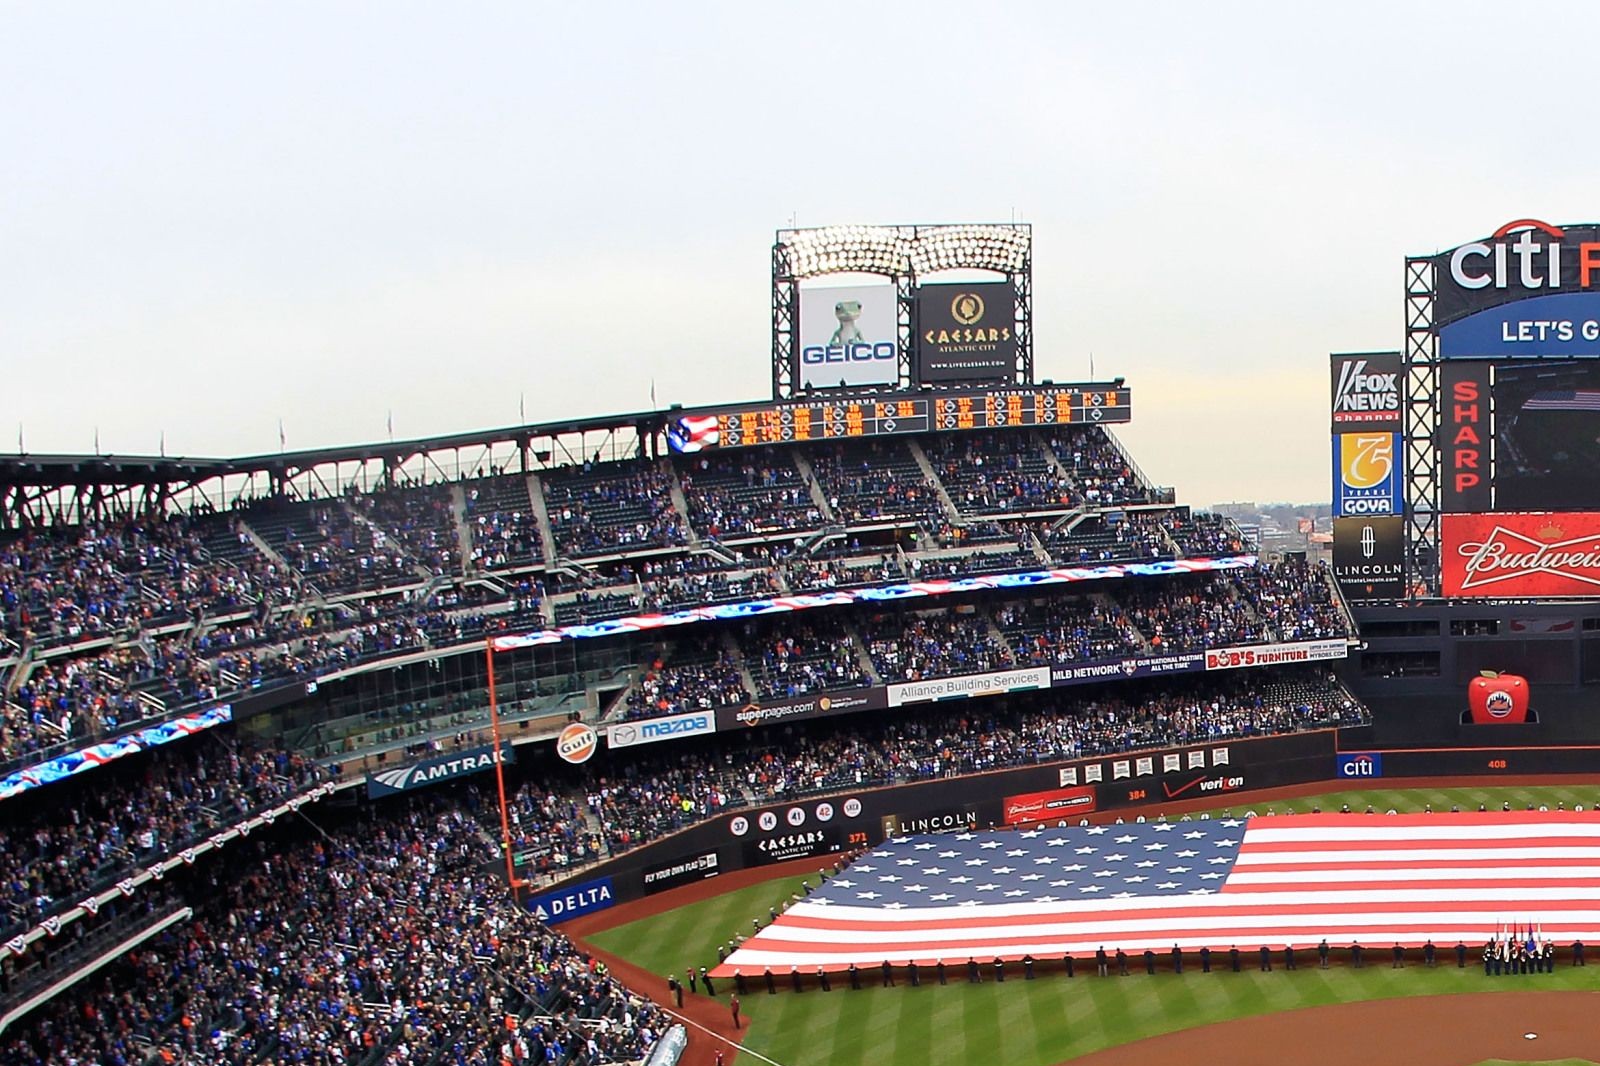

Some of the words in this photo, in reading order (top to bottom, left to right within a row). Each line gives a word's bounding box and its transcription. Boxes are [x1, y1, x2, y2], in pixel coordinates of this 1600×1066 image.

[1451, 231, 1560, 289] citi
[925, 328, 1010, 345] CAESARS
[1502, 320, 1574, 342] LET'S
[803, 341, 896, 365] GEICO
[939, 345, 977, 353] ATLANTIC
[1355, 374, 1397, 393] FOX
[987, 389, 1035, 397] NATIONAL
[776, 401, 830, 411] AMERICAN
[1343, 393, 1398, 411] NEWS
[1334, 413, 1399, 422] channel
[1454, 382, 1480, 492] SHARP
[1342, 436, 1392, 489] 75
[1344, 499, 1391, 513] GOYA
[1336, 564, 1402, 577] LINCOLN
[1137, 659, 1150, 667] OUR
[1151, 656, 1178, 666] NATIONAL
[1179, 653, 1204, 662] PASTIME
[1207, 651, 1255, 668] BOB'S
[1257, 650, 1308, 664] FURNITURE
[1052, 669, 1072, 681] MLB
[1074, 664, 1121, 678] NETWORK
[1151, 664, 1161, 672] ALL
[1162, 663, 1174, 671] THE
[900, 686, 943, 698] Alliance
[947, 679, 991, 692] Building
[994, 672, 1040, 687] Services
[736, 702, 814, 722] superpages.com
[561, 732, 593, 754] Gulf
[412, 748, 507, 784] AMTRAK
[1343, 759, 1373, 776] citi
[1488, 760, 1507, 769] 408
[1200, 775, 1243, 791] verizon
[1129, 789, 1145, 800] 384
[791, 812, 800, 821] 41
[819, 807, 830, 816] 42
[734, 821, 745, 831] 37
[764, 816, 772, 826] 14
[901, 812, 976, 833] LINCOLN
[759, 830, 824, 852] CAESARS
[848, 832, 868, 843] 371
[771, 847, 799, 857] ATLANTIC
[645, 873, 655, 883] FLY
[656, 868, 671, 880] YOUR
[671, 864, 685, 876] OWN
[685, 861, 698, 872] FLAG
[552, 885, 612, 917] DELTA
